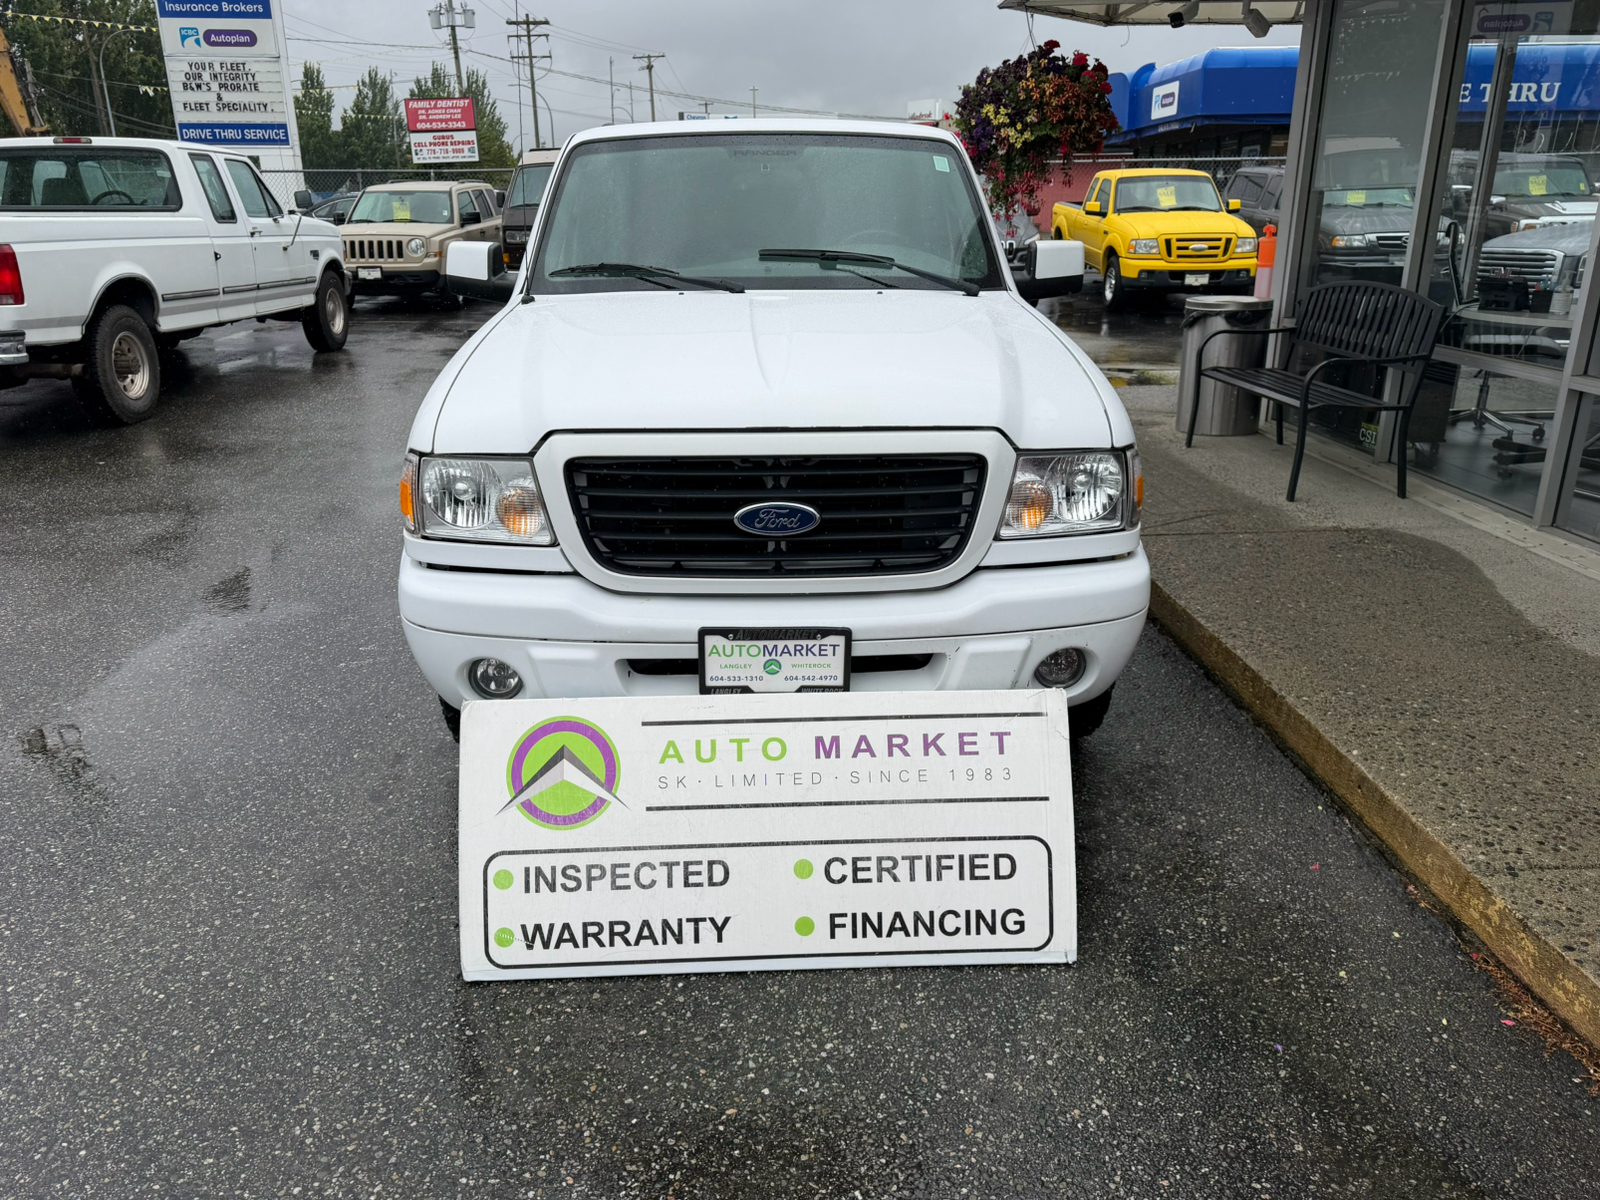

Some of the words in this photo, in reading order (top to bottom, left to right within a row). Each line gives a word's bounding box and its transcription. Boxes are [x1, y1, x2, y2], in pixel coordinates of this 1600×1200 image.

[165, 2, 219, 12] Insurance
[222, 2, 264, 13] Brokers
[210, 34, 250, 44] Autoplan
[187, 62, 215, 71] YOUR
[219, 62, 252, 71] FLEET.
[184, 72, 203, 81] OUR
[209, 72, 256, 82] INTEGRITY
[182, 82, 212, 92] B&W'S
[218, 82, 260, 92] PRORATE
[216, 92, 223, 101] &
[182, 102, 210, 111] FLEET
[436, 99, 470, 108] DENTIST
[182, 128, 213, 140] DRIVE
[213, 128, 242, 140] THRU
[244, 129, 286, 140] SERVICE
[754, 508, 801, 528] Ford
[708, 643, 841, 658] AUTOMARKET
[658, 736, 787, 764] AUTO
[814, 731, 1012, 760] MARKET
[715, 771, 822, 788] LIMITED
[850, 769, 928, 784] SINCE
[949, 766, 1012, 782] 1983
[824, 853, 1017, 885] CERTIFIED
[523, 859, 731, 894] INSPECTED
[829, 908, 1026, 940] FINANCING
[520, 916, 732, 951] WARRANTY
